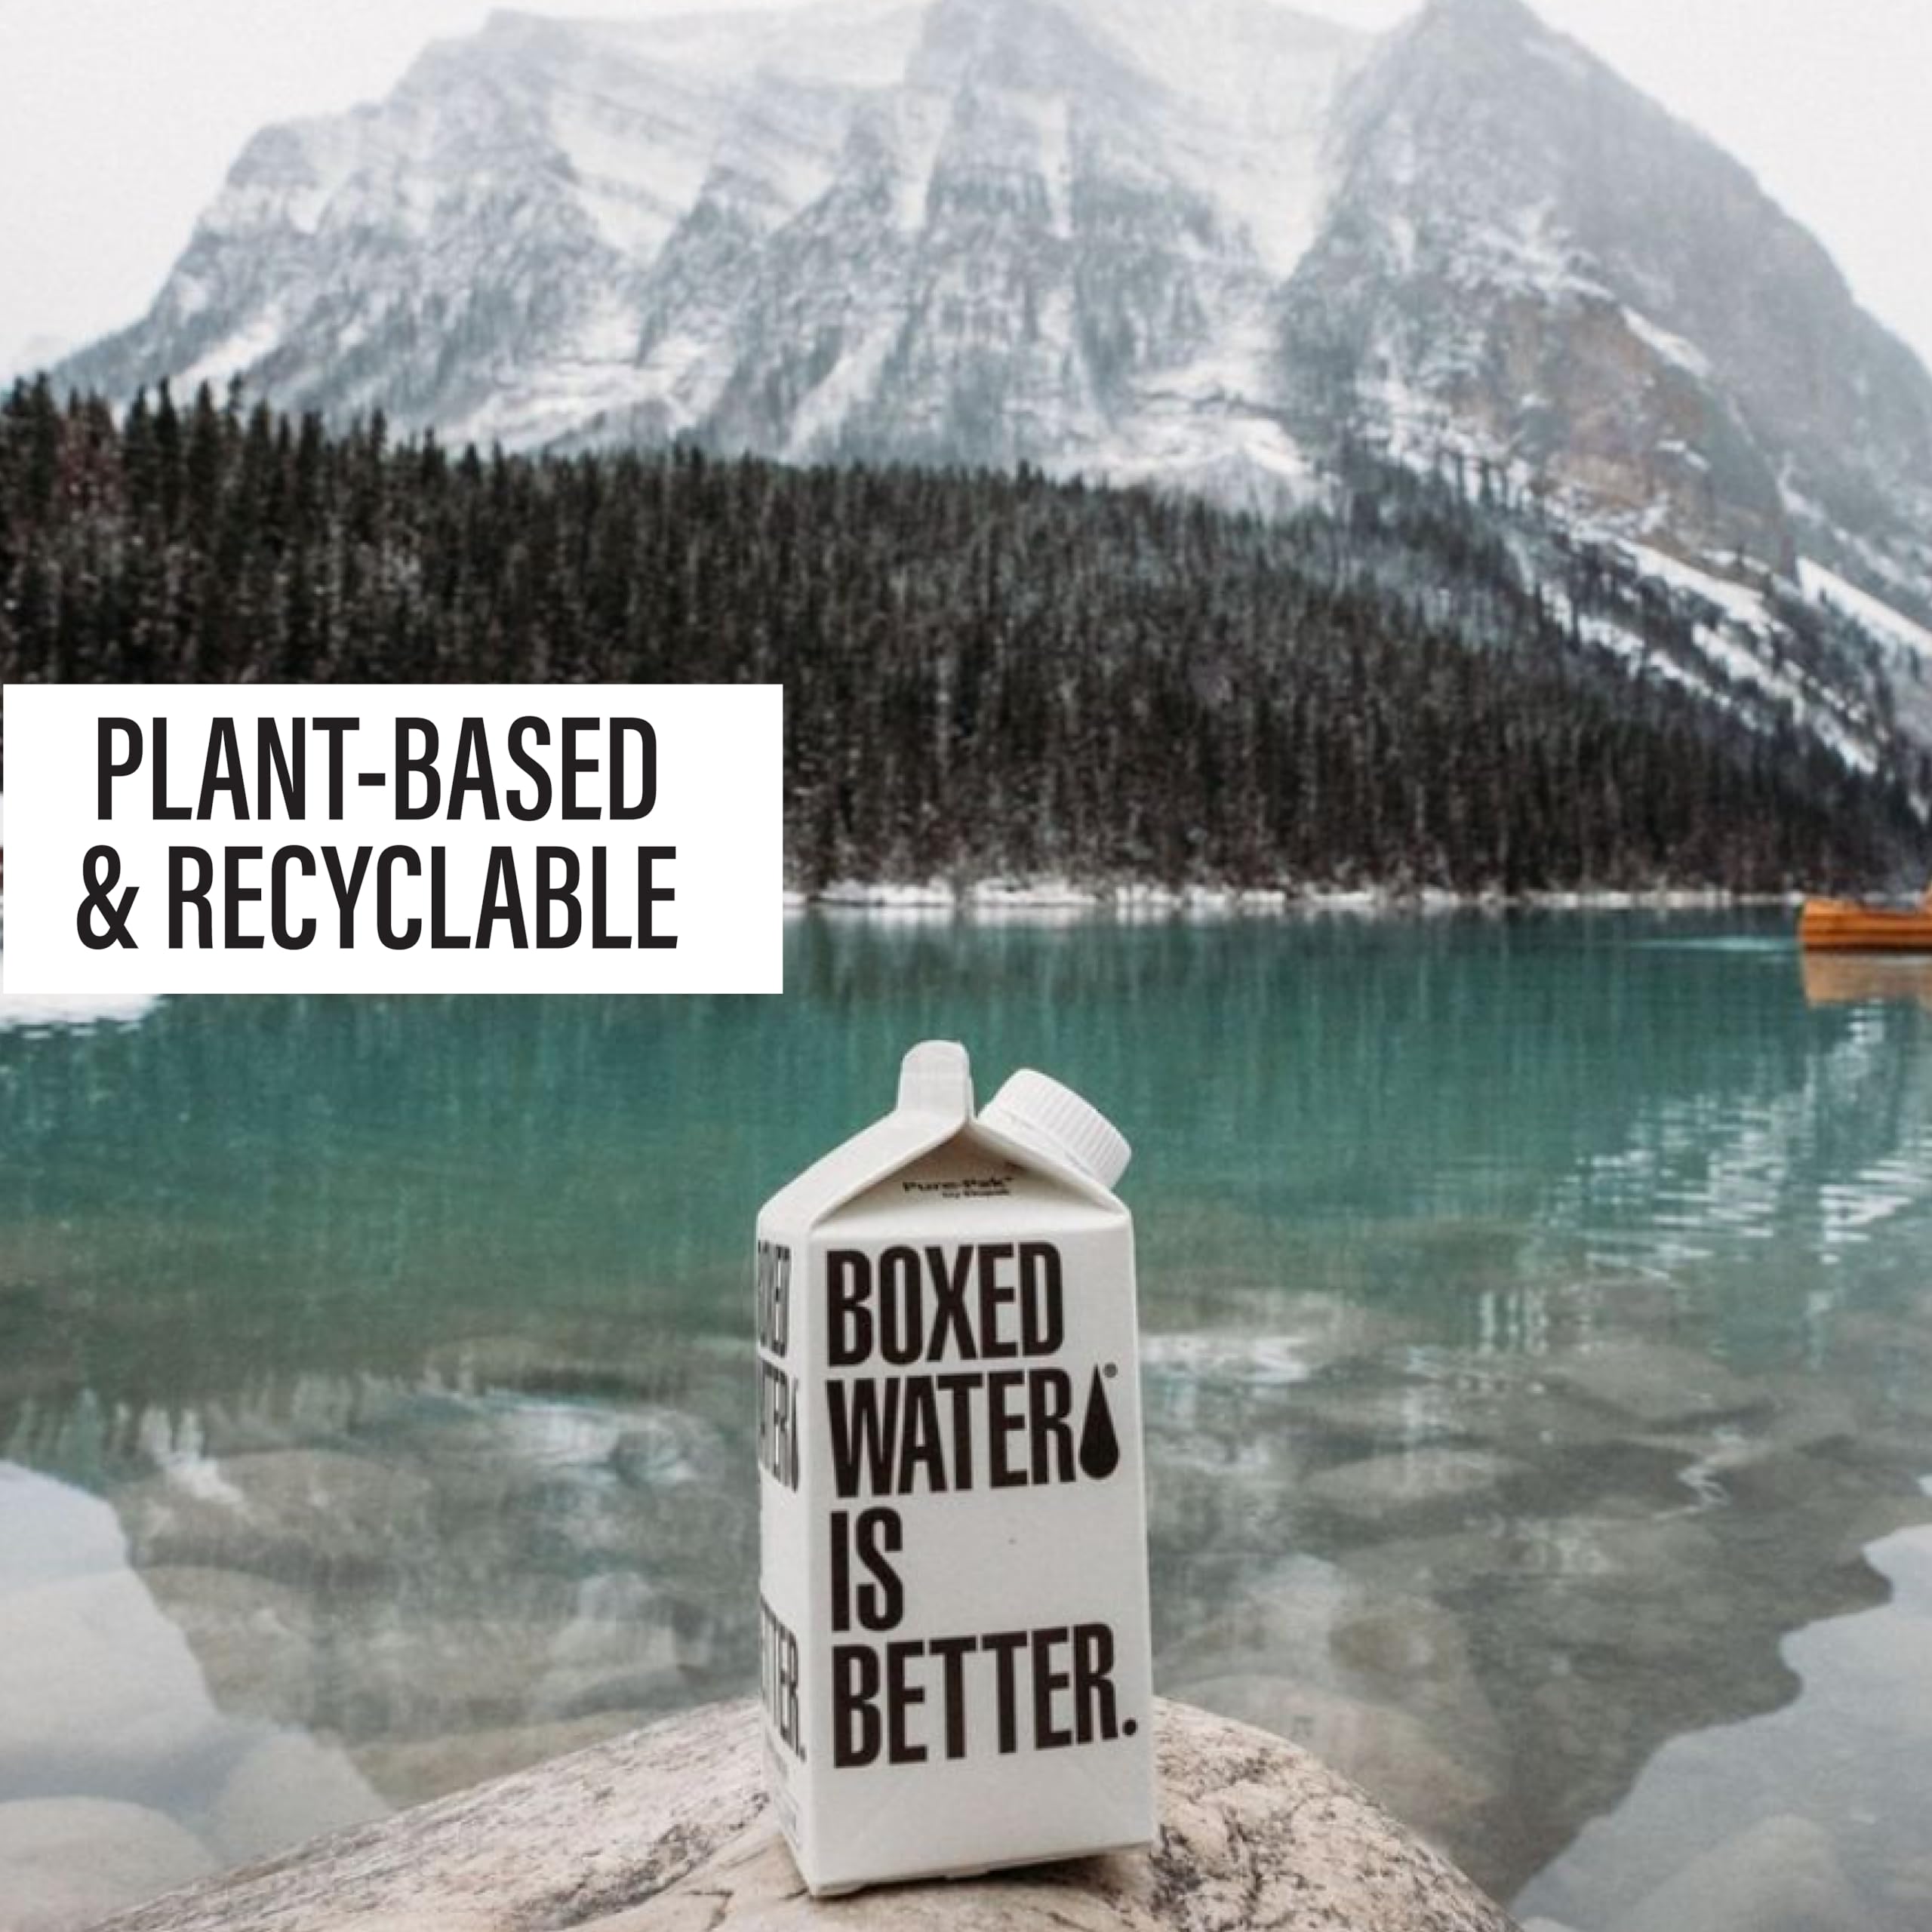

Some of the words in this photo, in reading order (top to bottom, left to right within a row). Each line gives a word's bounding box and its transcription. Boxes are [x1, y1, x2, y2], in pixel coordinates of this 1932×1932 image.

[826, 1241, 1065, 1367] BOXED
[826, 1368, 1077, 1499] WATER
[831, 1506, 903, 1631] IS
[832, 1622, 1138, 1768] BETTER.
